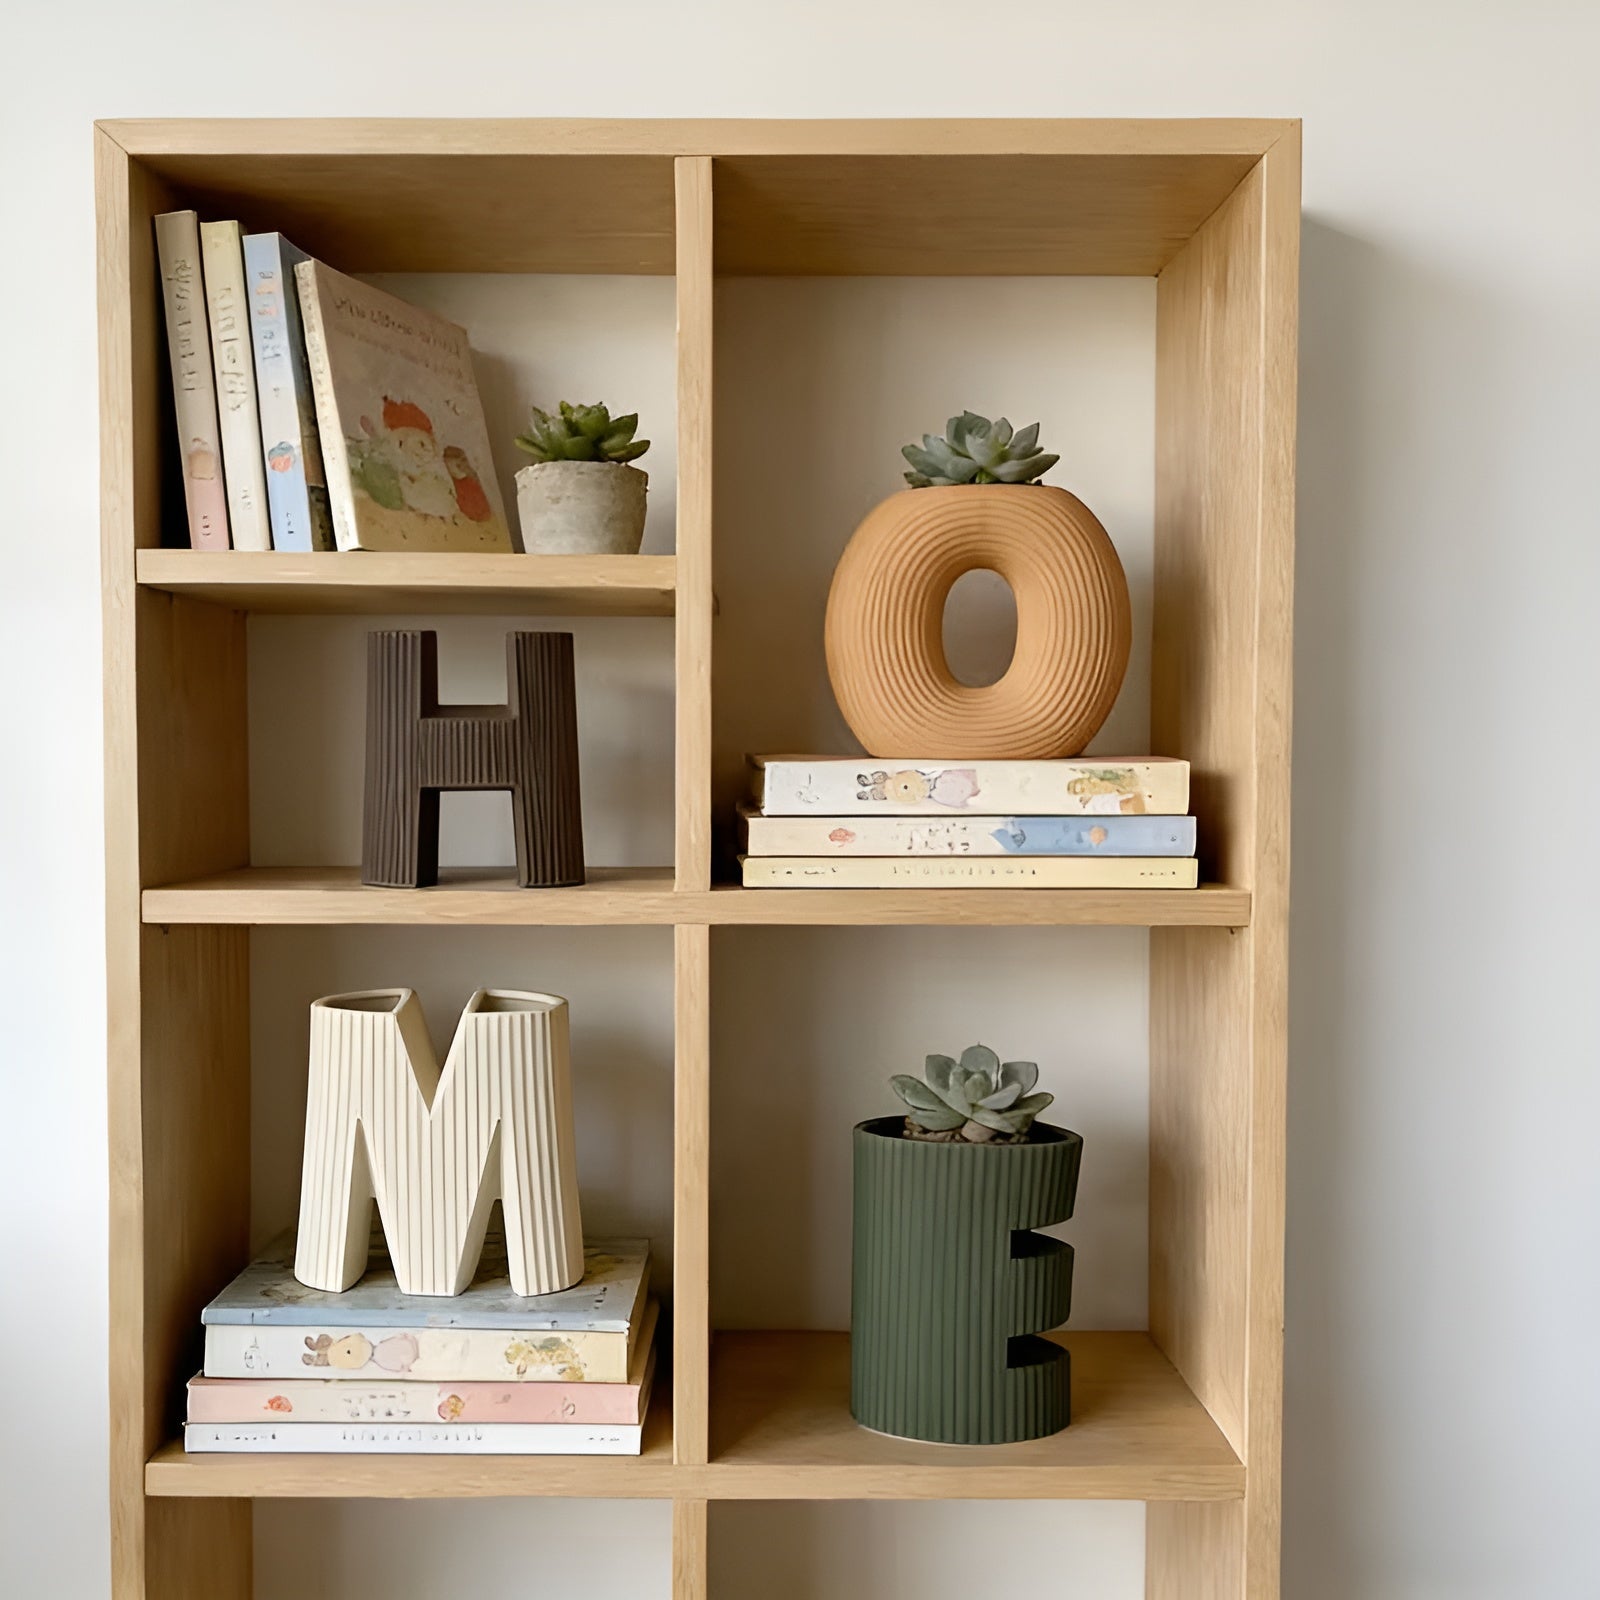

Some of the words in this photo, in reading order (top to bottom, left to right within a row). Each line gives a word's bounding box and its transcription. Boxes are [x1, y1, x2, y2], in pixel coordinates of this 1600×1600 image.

[361, 630, 585, 889] H
[824, 483, 1132, 760] O
[294, 987, 584, 1298] M
[851, 1115, 1083, 1444] E
